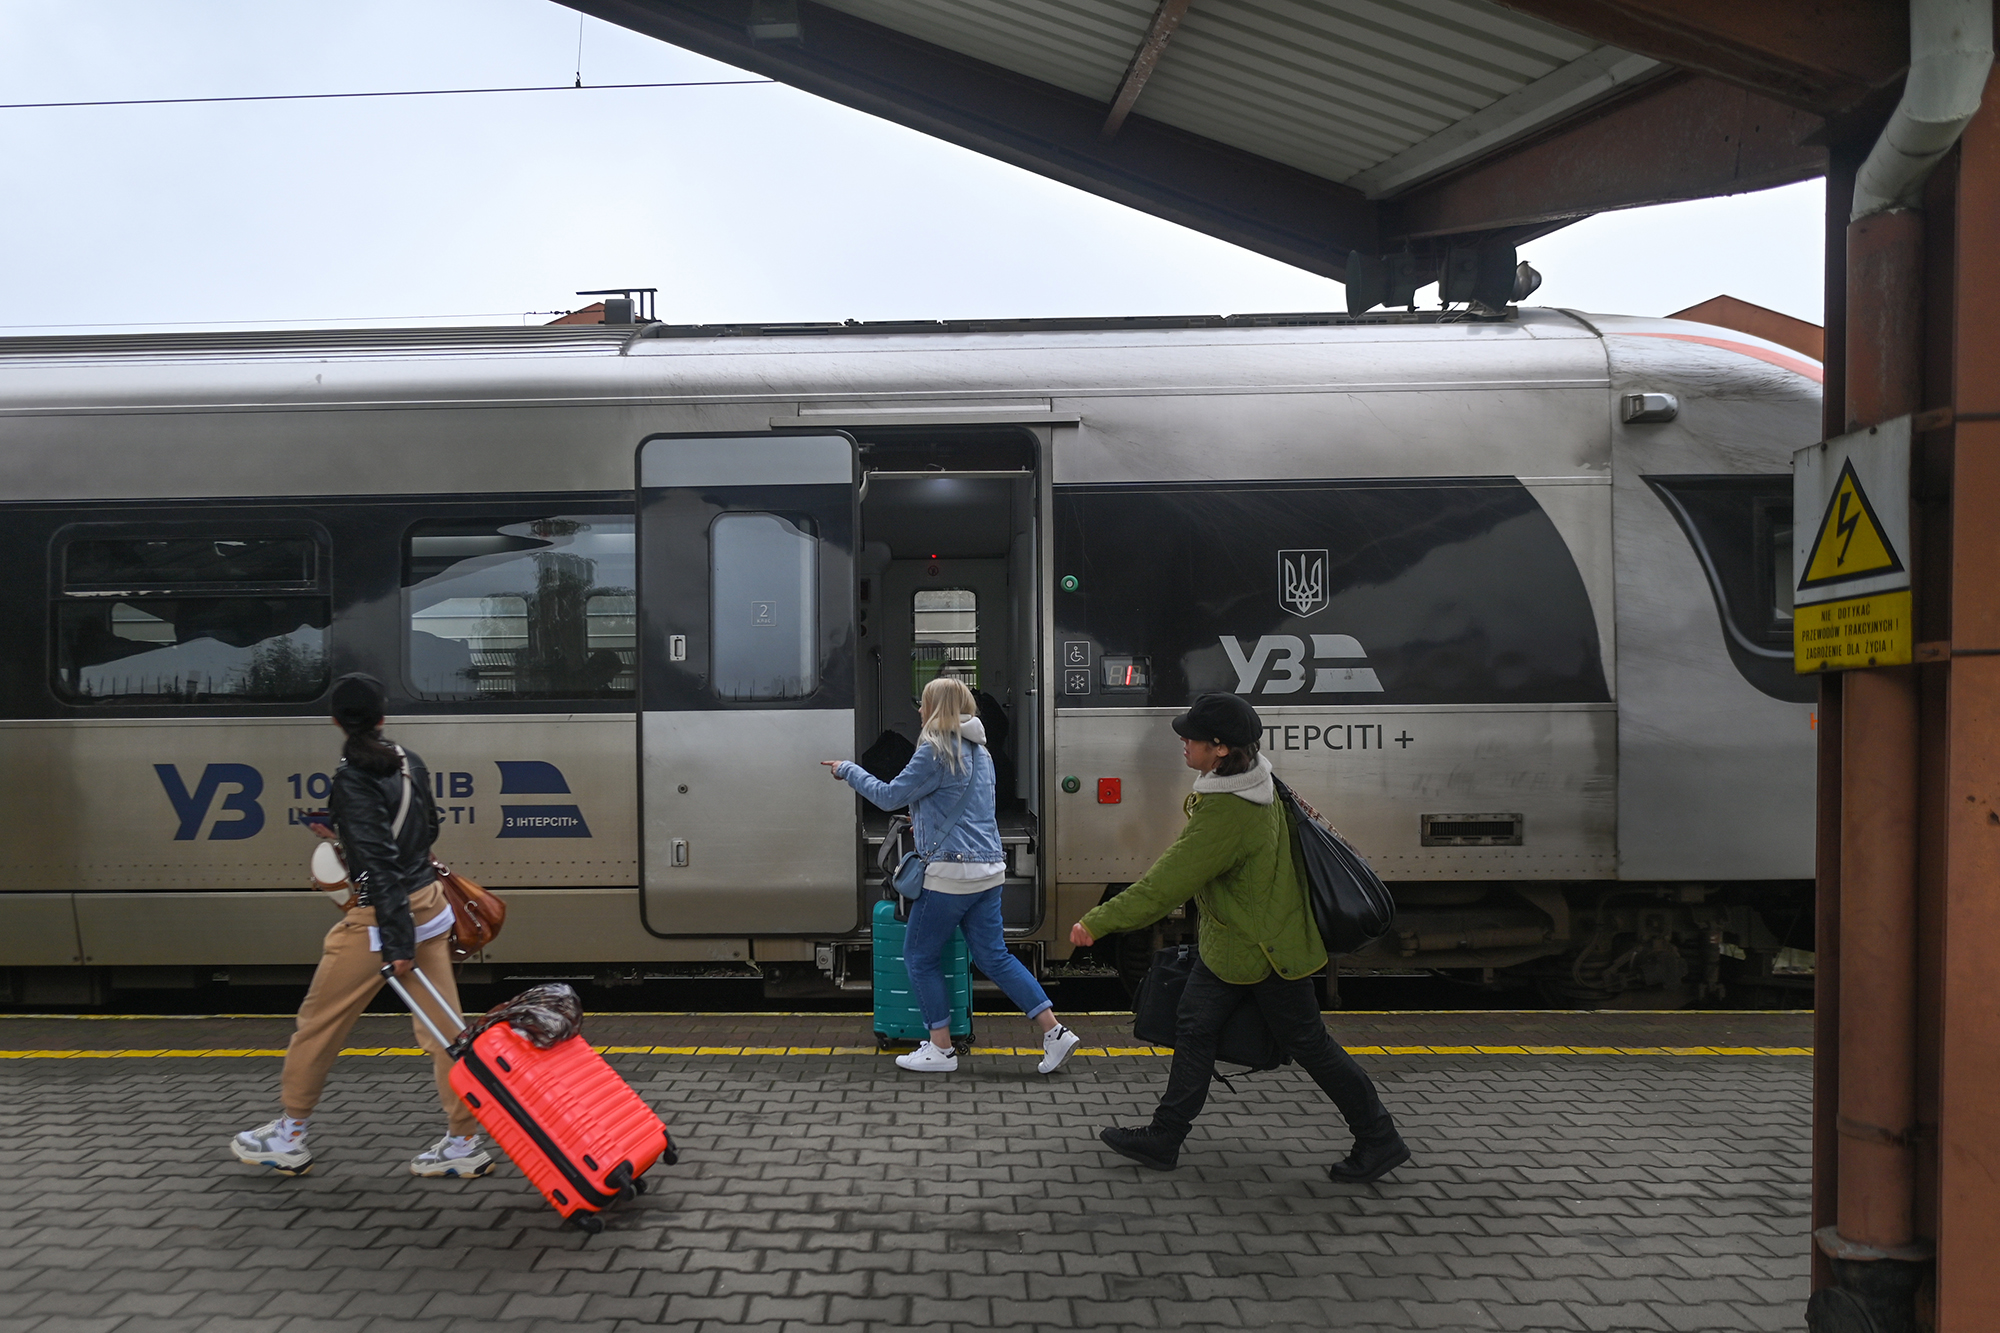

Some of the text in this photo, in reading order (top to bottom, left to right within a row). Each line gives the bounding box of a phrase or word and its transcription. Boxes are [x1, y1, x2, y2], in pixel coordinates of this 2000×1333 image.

[760, 604, 768, 617] 2
[1821, 603, 1871, 622] NIE DOTYKAĆ
[1801, 624, 1840, 642] PRZEWODÓW
[1844, 619, 1893, 637] TRAKCYJNYCH
[1806, 643, 1842, 660] ZAGROŻENIE
[1846, 642, 1860, 656] DLA
[1865, 639, 1887, 654] ŻYCIA
[1262, 724, 1383, 751] ТЕРСІТІ
